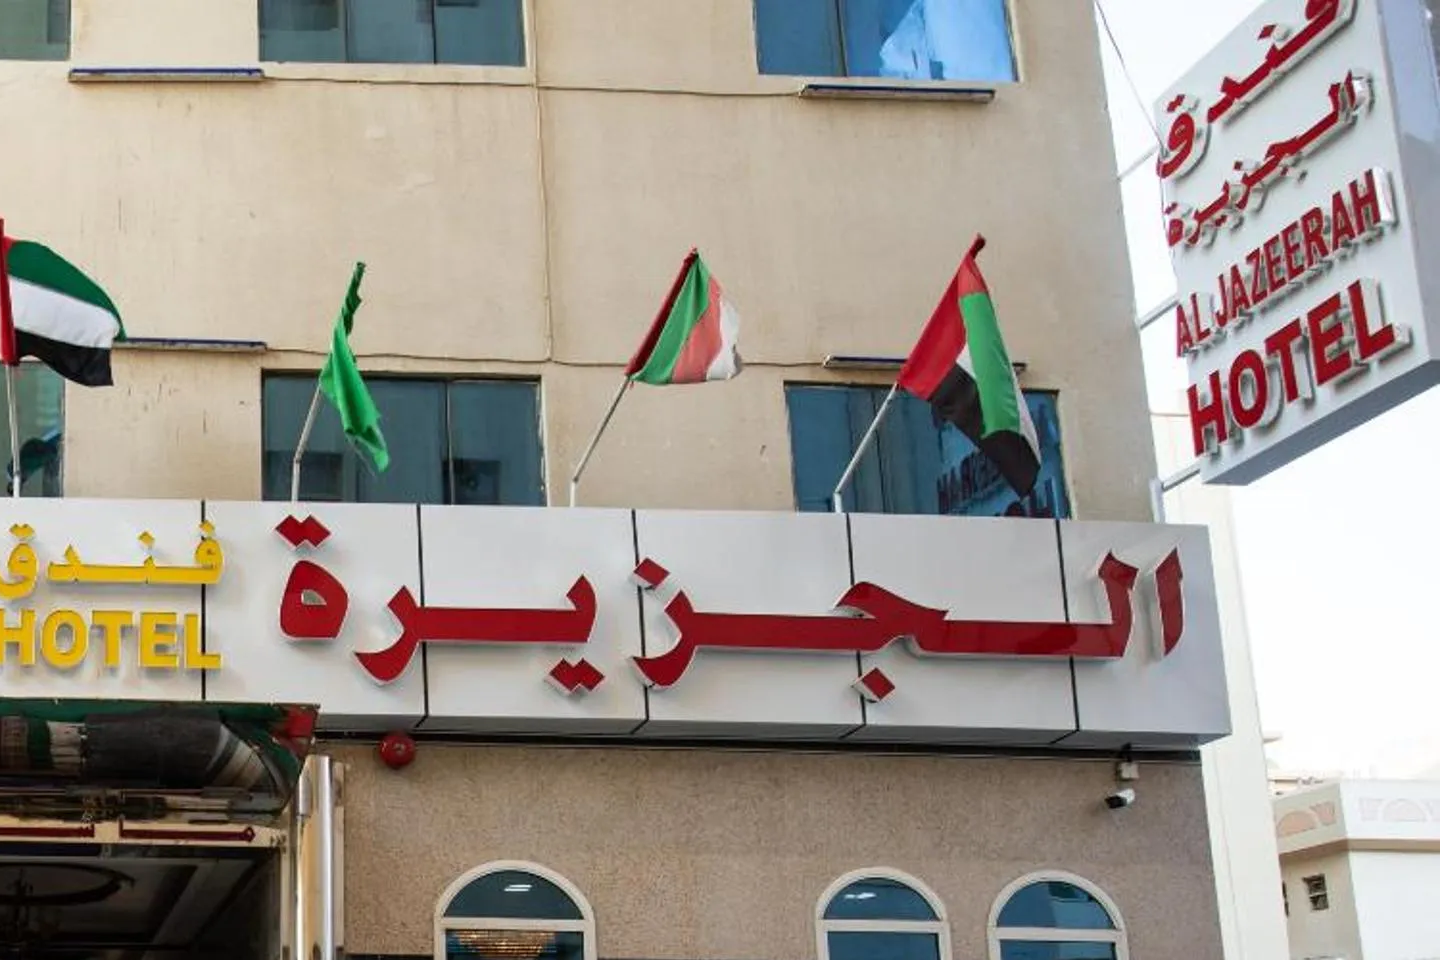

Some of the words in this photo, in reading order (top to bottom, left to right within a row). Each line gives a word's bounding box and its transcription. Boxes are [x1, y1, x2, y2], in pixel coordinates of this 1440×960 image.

[1165, 69, 1357, 247] الجزيرة
[1176, 292, 1211, 358] AL
[1215, 167, 1382, 328] JAZEERAH
[1186, 278, 1396, 457] HOTEL
[275, 514, 1184, 700] الجزيرة
[117, 818, 257, 843] ما
